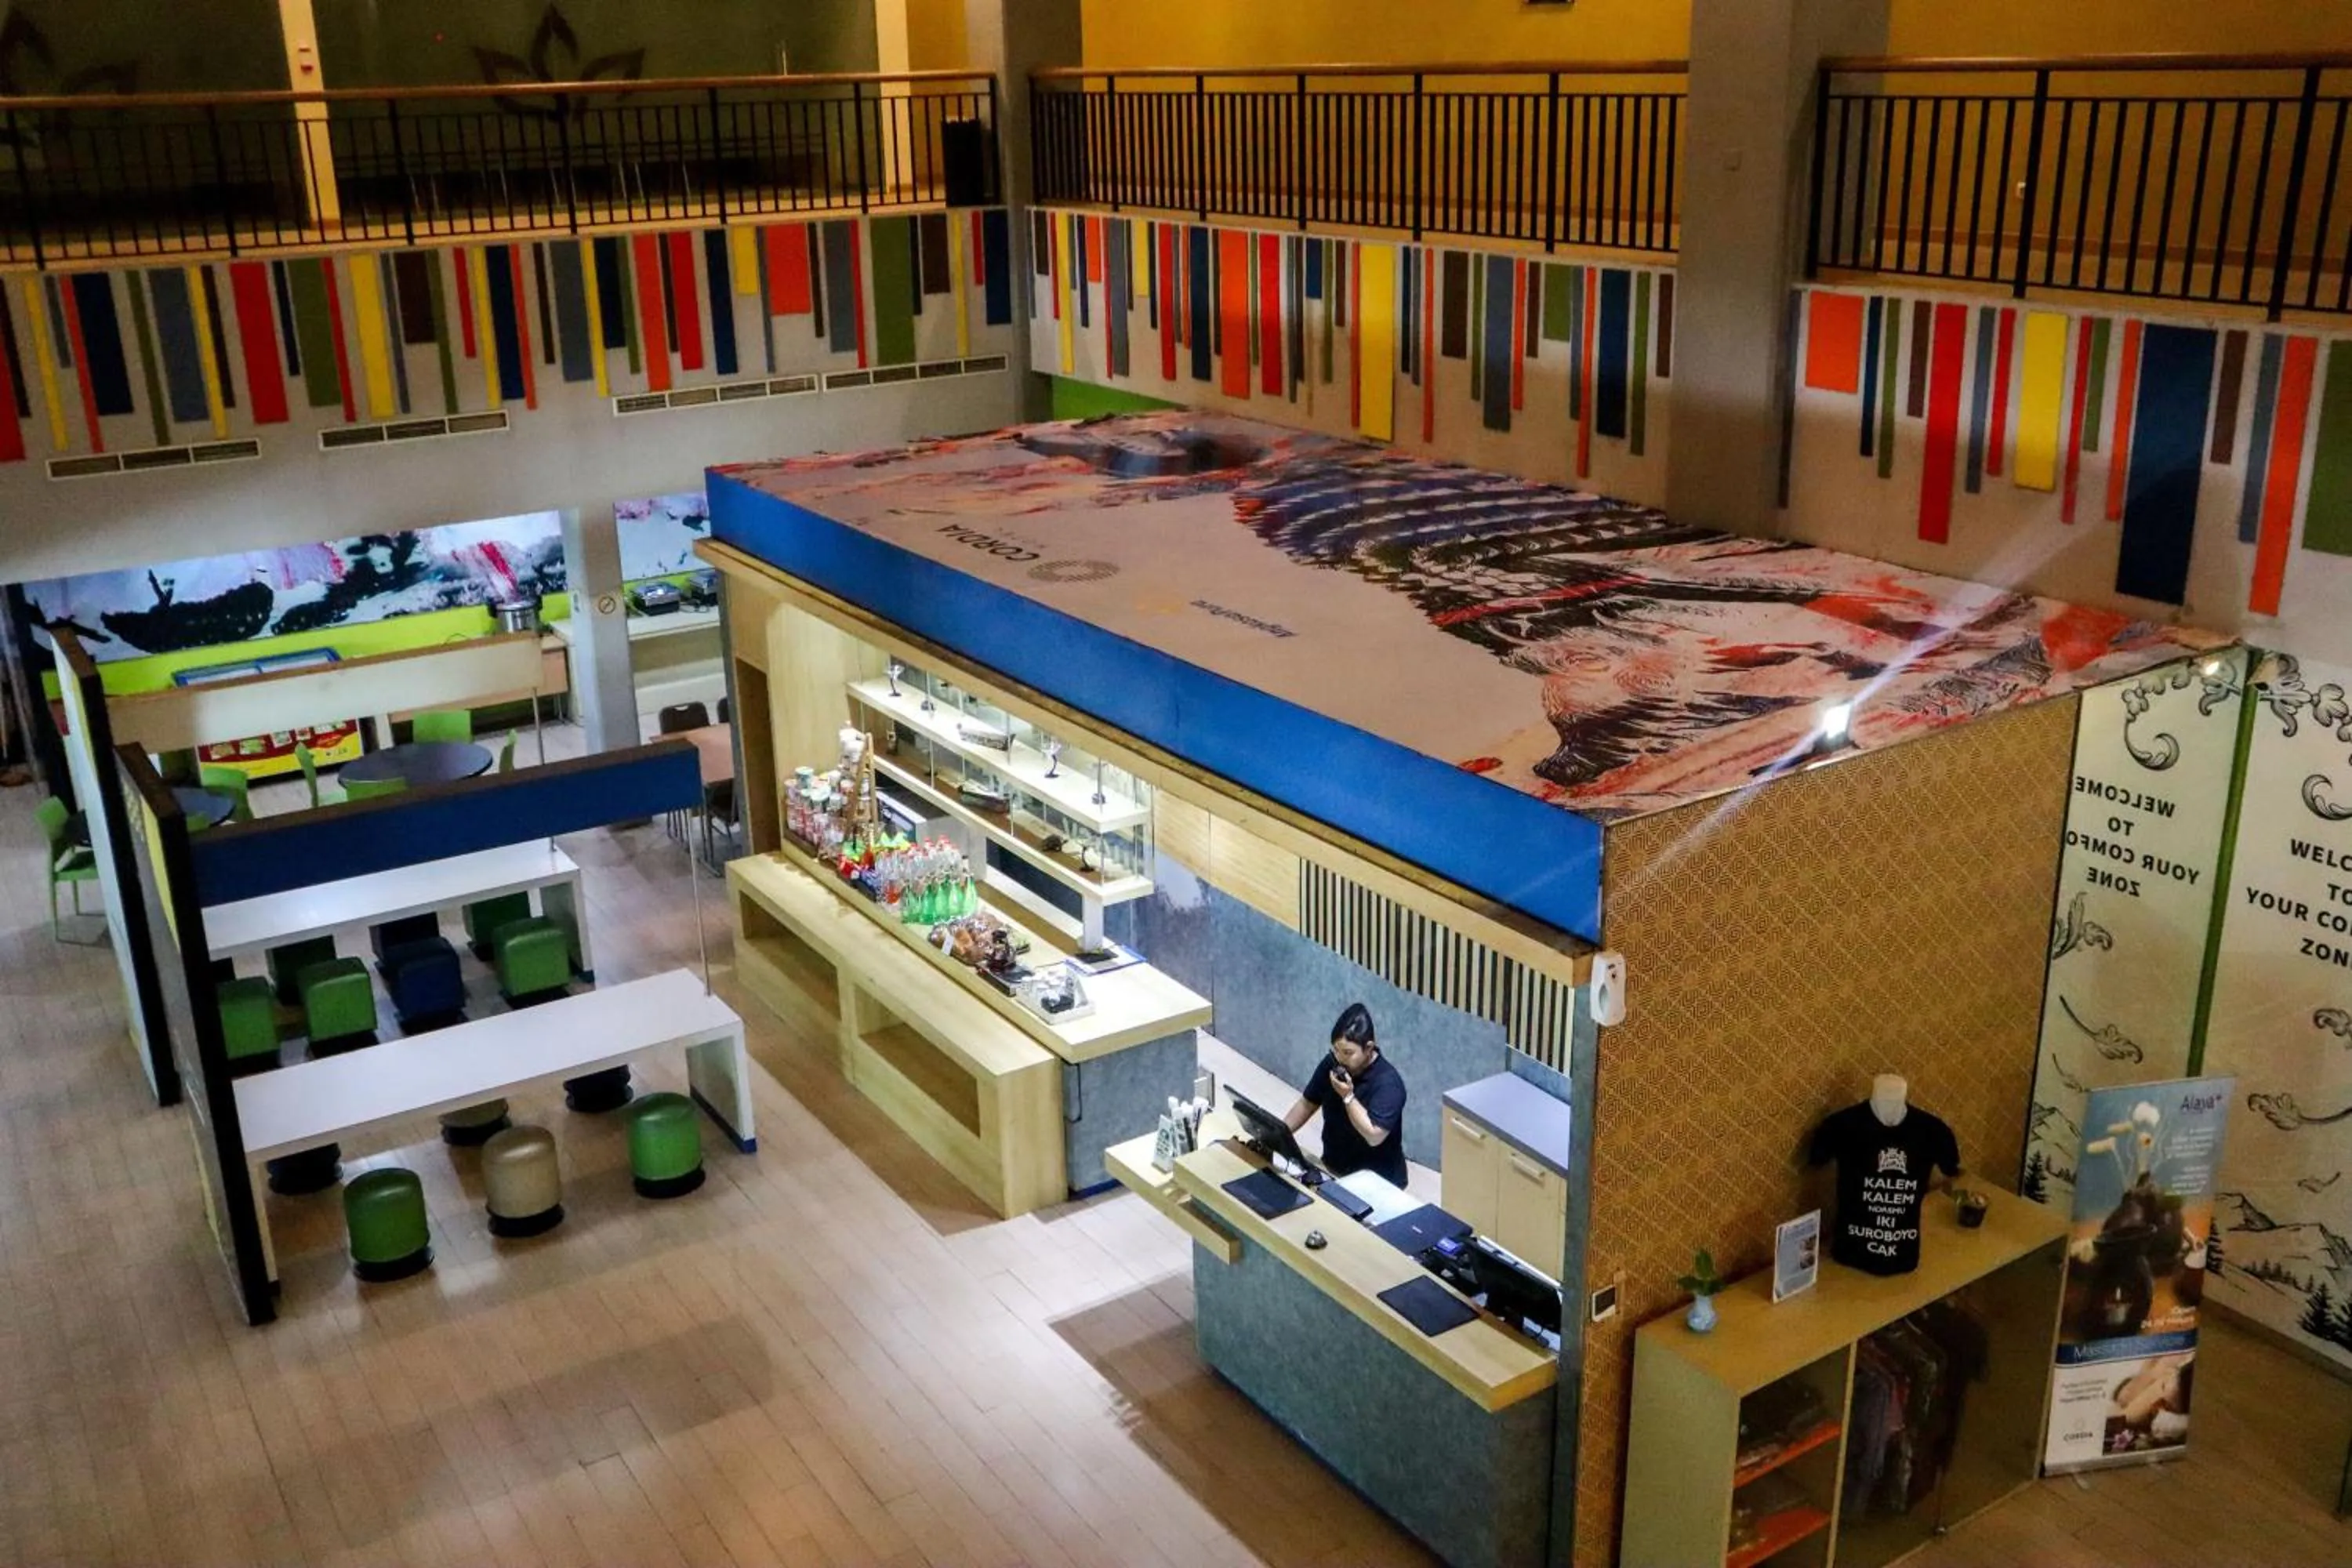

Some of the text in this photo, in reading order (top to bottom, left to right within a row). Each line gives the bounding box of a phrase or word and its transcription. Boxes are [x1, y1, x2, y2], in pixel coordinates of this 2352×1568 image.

[935, 524, 1040, 561] CORDIA
[2246, 886, 2352, 937] YOUR CO
[2300, 937, 2352, 967] ZON
[1864, 1177, 1918, 1191] KALEM
[1862, 1191, 1915, 1204] KALEM
[1876, 1215, 1896, 1228] IKI
[1848, 1224, 1918, 1242] SUROBOYO
[1867, 1241, 1897, 1256] CAK
